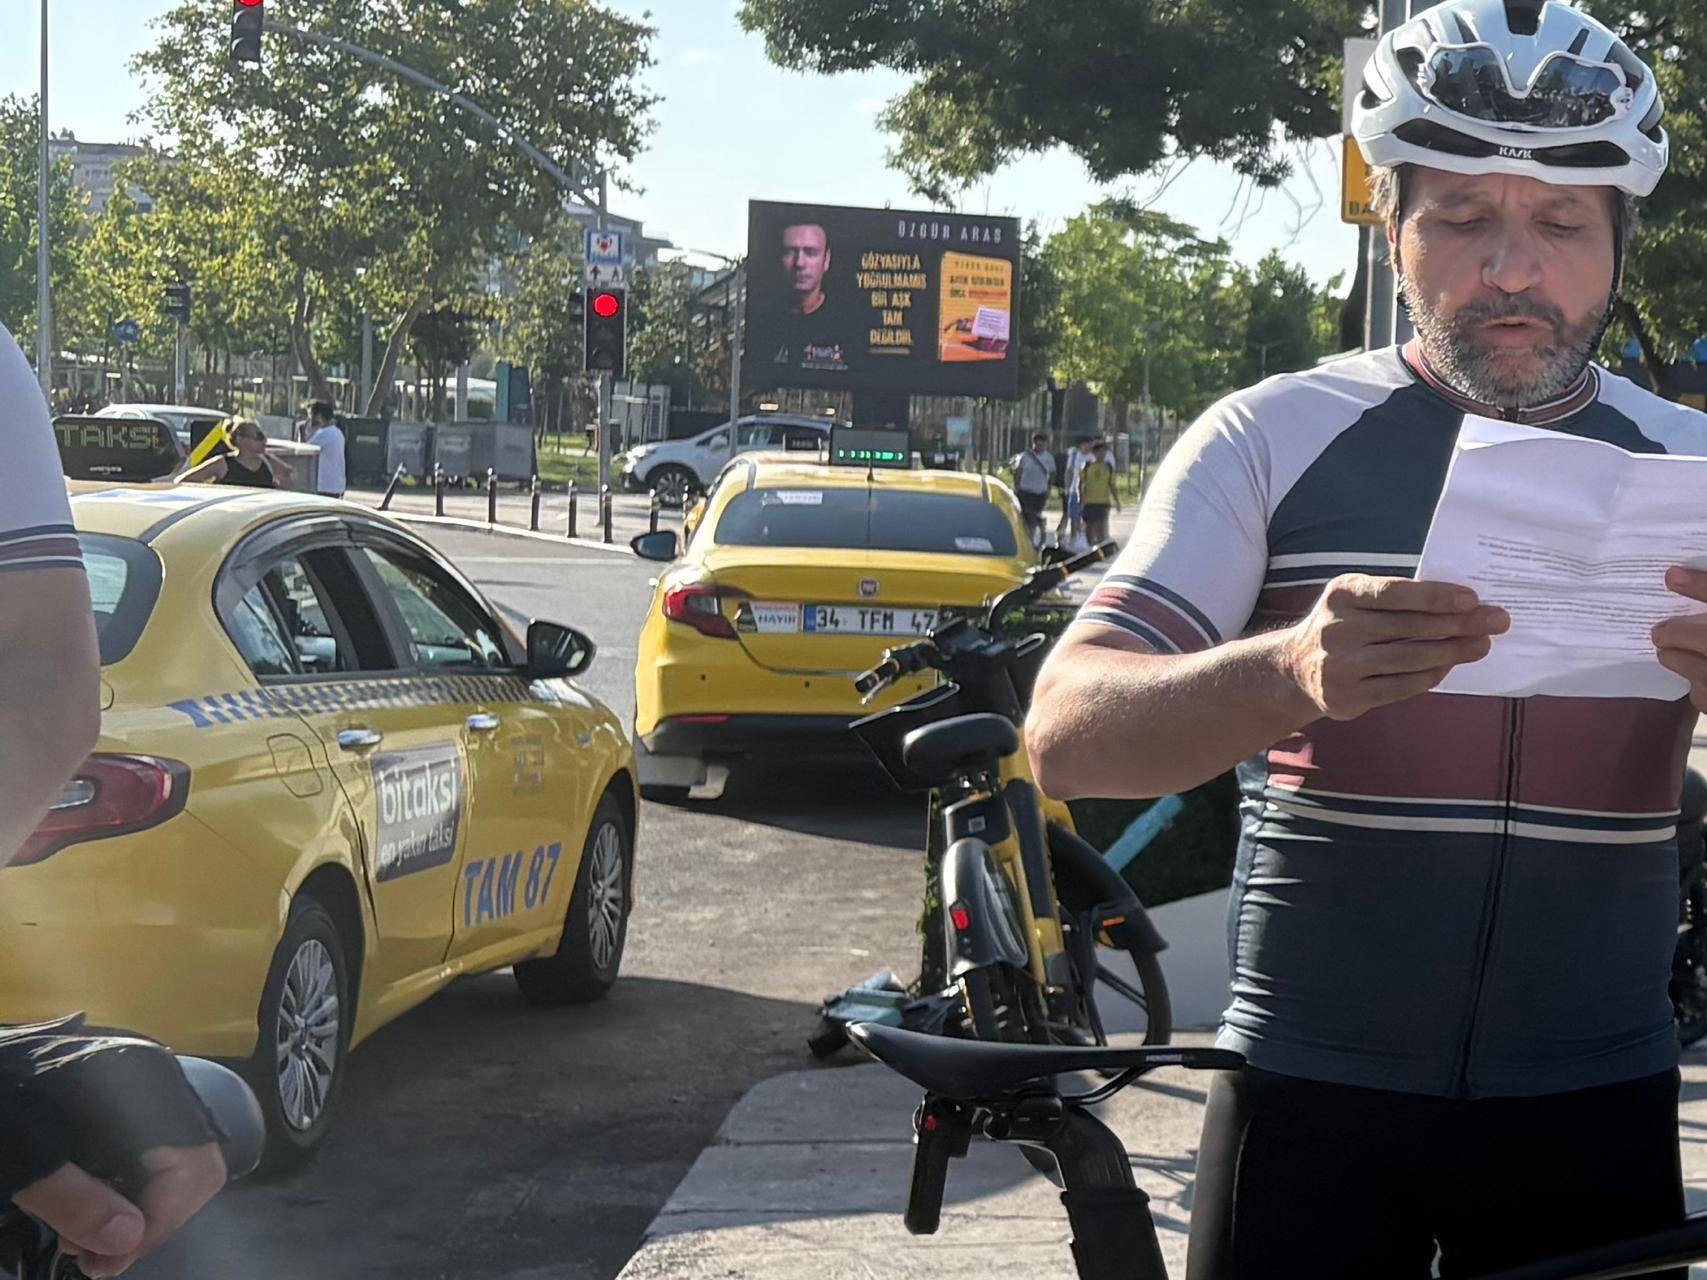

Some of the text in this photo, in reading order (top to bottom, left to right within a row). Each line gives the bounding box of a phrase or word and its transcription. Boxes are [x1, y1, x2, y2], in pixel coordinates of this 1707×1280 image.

[817, 608, 841, 628] 34
[378, 758, 457, 825] bitaksi
[380, 841, 396, 865] en
[465, 841, 562, 928] TAM 87
